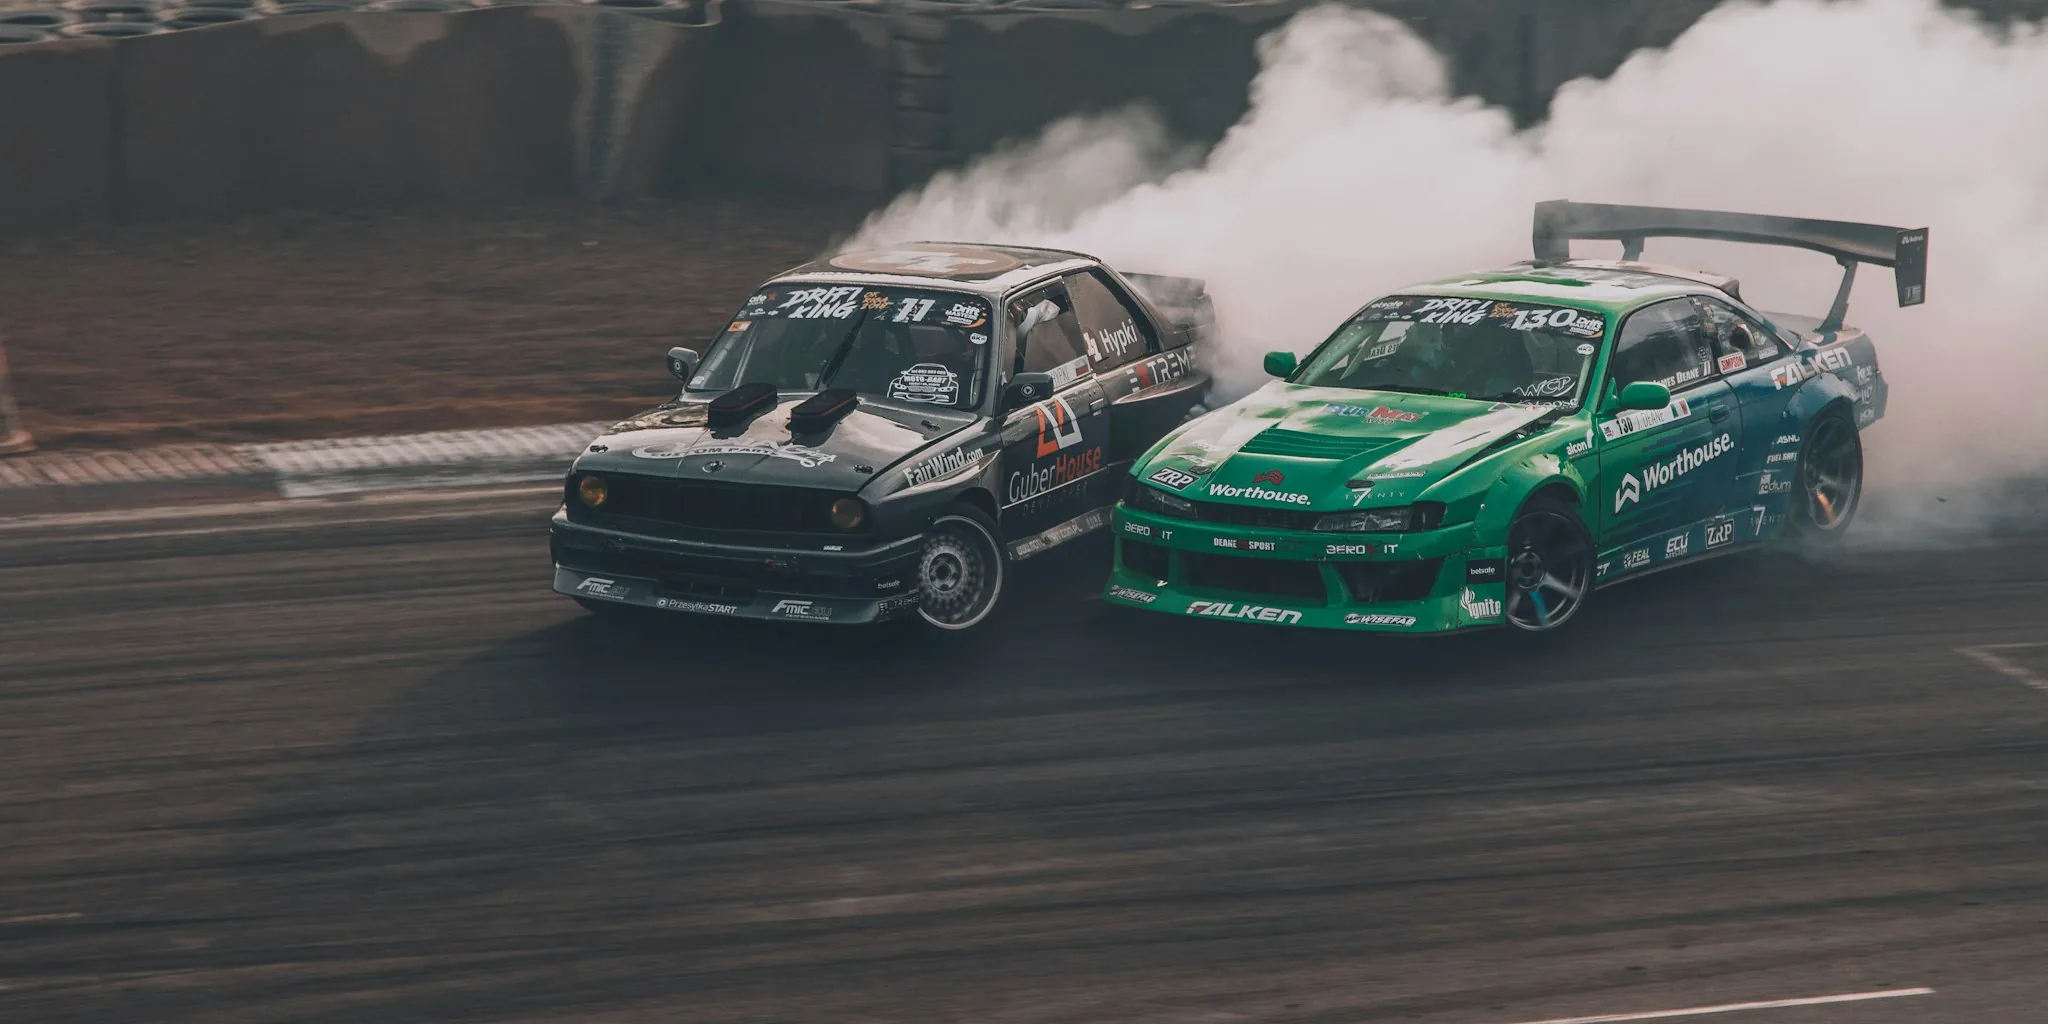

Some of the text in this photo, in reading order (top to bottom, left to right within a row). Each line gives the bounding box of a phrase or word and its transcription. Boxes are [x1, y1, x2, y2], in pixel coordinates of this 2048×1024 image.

[777, 286, 864, 308] DRIFT
[788, 301, 858, 320] KING
[945, 310, 979, 321] MASTERS
[953, 303, 981, 316] Drift
[1420, 310, 1487, 326] KING
[1511, 309, 1578, 331] 130
[1099, 319, 1138, 357] Hypki
[1721, 356, 1744, 371] SIMPSON
[1770, 347, 1853, 391] FALKEN
[1653, 368, 1699, 388] MES DEANE
[1616, 417, 1634, 435] 130
[1566, 440, 1587, 455] alcon
[902, 447, 984, 487] FairWind.com
[1643, 432, 1735, 492] Worthouse.
[1150, 467, 1194, 487] ZRP
[1209, 483, 1312, 506] Worthouse.
[1352, 488, 1372, 507] 7
[1753, 506, 1765, 536] 7
[1707, 523, 1733, 545] ZRP
[1213, 538, 1276, 551] DEANE SPORT
[1632, 547, 1651, 563] FEAL
[1470, 566, 1496, 575] betsafe
[1117, 588, 1157, 603] WISEFAB
[1186, 601, 1303, 624] FALKEN
[1468, 599, 1501, 619] ignite
[1360, 614, 1418, 626] WISEFAB
